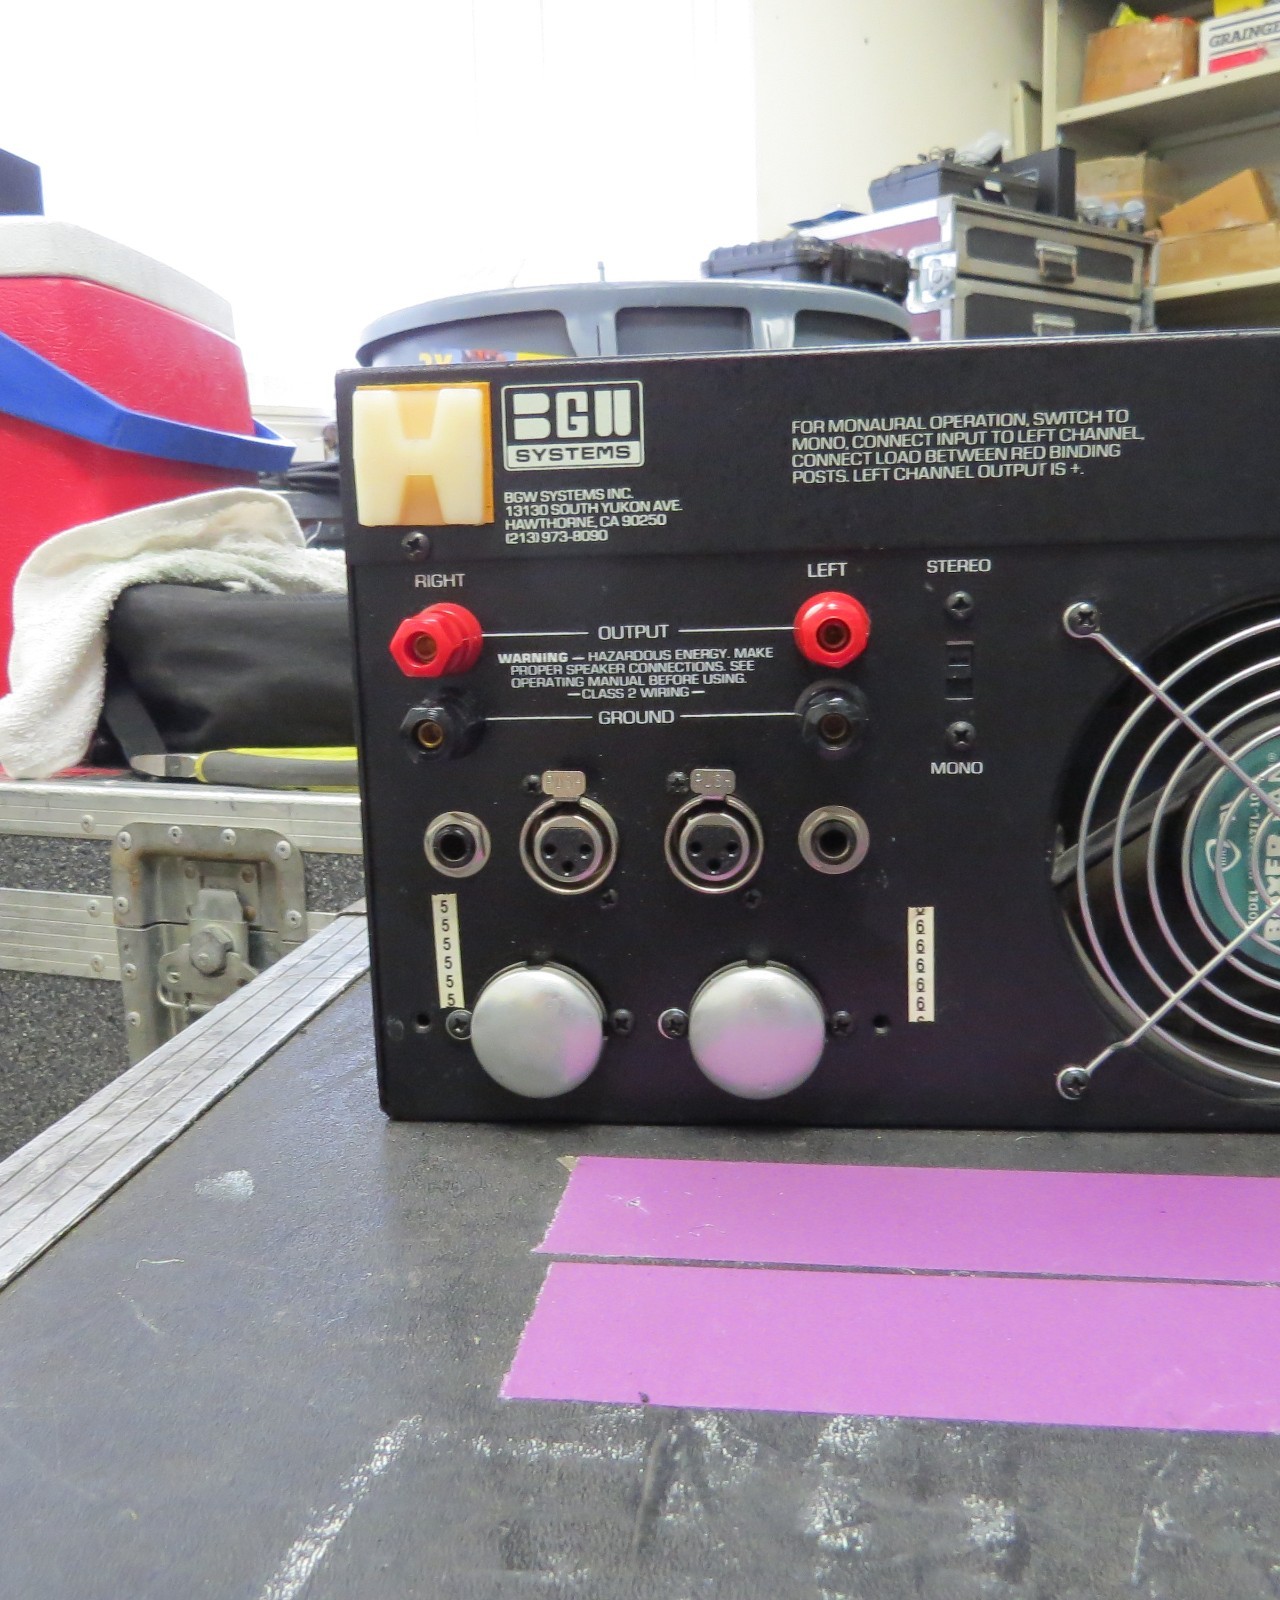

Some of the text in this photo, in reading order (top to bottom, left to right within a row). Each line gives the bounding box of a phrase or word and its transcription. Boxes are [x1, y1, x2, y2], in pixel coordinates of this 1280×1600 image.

[512, 389, 632, 440] BGW
[791, 420, 825, 434] FOR
[827, 417, 927, 432] MONAURAL
[1032, 410, 1102, 425] SWITCH
[1105, 409, 1129, 423] TO
[852, 433, 934, 449] CONNECT
[936, 431, 986, 446] INPUT
[989, 430, 1014, 444] TO
[1018, 428, 1056, 443] LEFT
[515, 445, 631, 462] SYSTEMS
[791, 444, 1121, 468] CONNECT LOAD BETWEEN RED BINDING
[853, 468, 891, 483] LEFT
[893, 465, 975, 481] CHANNEL
[977, 462, 1049, 478] OUTPUT
[1050, 462, 1067, 476] IS
[503, 491, 538, 504] BGW
[539, 488, 605, 502] SYSTEMS
[505, 504, 548, 517] 13130
[550, 502, 599, 515] SOUTH
[601, 501, 651, 514] YUKON
[600, 515, 619, 527] CA
[623, 513, 667, 526] 90250
[541, 529, 609, 543] 973-8090
[807, 561, 848, 578] LEFT
[926, 558, 992, 574] STEREO
[414, 573, 466, 588] RIGHT
[598, 624, 670, 640] OUTPUT
[497, 652, 569, 664] WARNING
[588, 650, 672, 663] HAZARDOUS
[734, 647, 774, 659] MAKE
[510, 664, 563, 676] PROPER
[566, 662, 626, 675] SPEAKER
[729, 660, 755, 672] SEE
[510, 676, 585, 689] OPERATING
[587, 675, 646, 688] MANUAL
[648, 673, 700, 686] BEFORE
[627, 687, 636, 700] 2
[598, 709, 675, 725] GROUND
[930, 761, 984, 775] MONO
